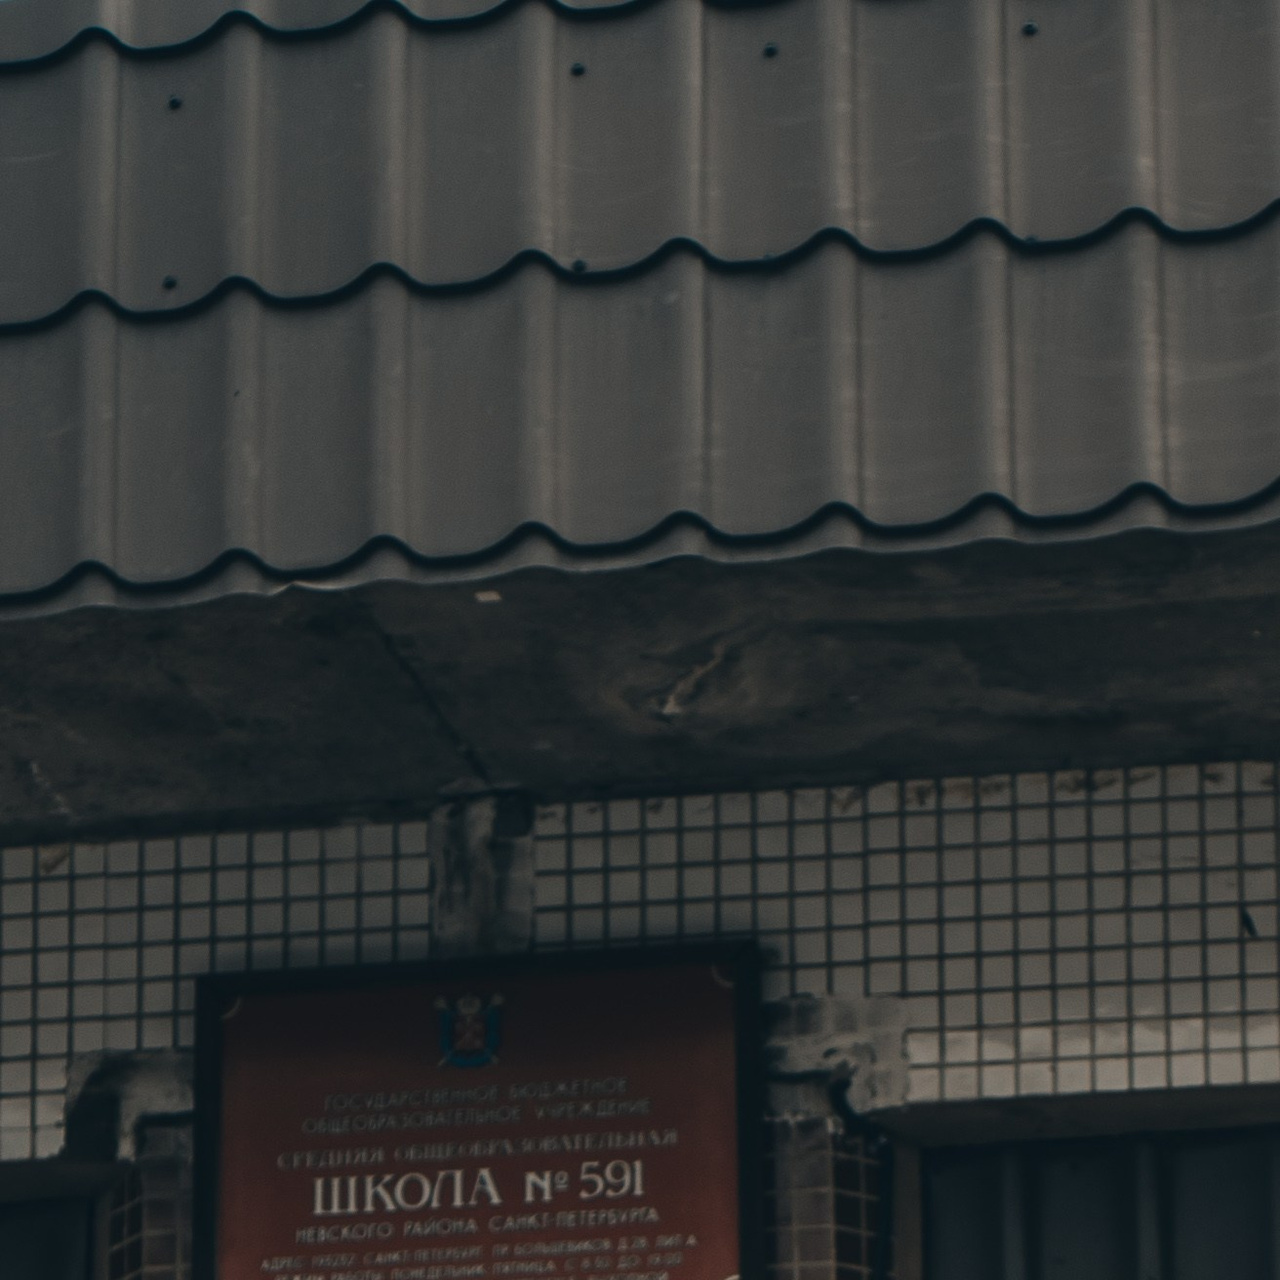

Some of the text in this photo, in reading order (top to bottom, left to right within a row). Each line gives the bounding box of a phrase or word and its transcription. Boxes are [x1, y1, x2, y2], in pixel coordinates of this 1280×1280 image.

[277, 1129, 677, 1169] СРЕДНЯЯ ОБЩЕОБРАЗОВАТЕЛЬНАЯ
[313, 1167, 502, 1215] ШКОЛА
[578, 1158, 645, 1200] 591
[296, 1207, 660, 1244] НЕВСКОГО РАЙОНА САНКТ-ПЕТЕРБУРГА
